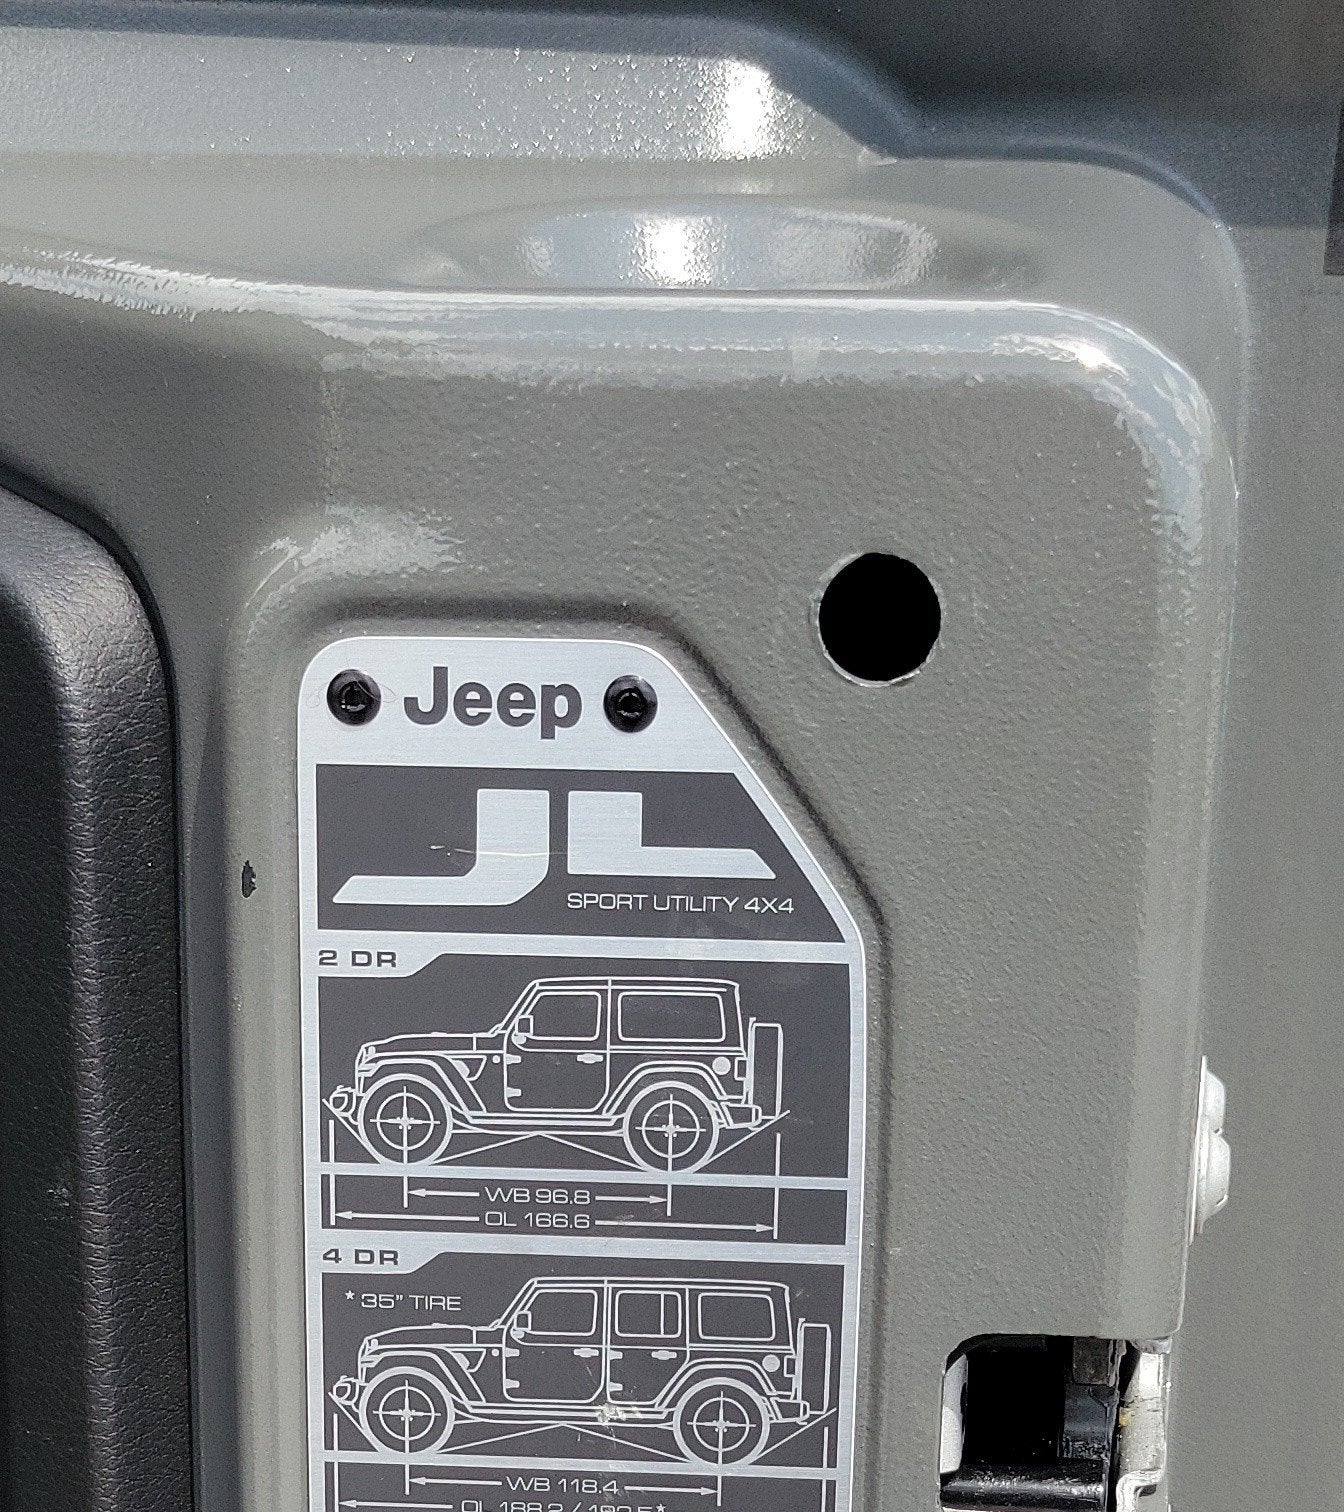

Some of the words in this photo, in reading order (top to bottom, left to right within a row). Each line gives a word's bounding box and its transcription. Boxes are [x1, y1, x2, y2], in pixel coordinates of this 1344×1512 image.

[403, 666, 582, 740] Jeep
[333, 788, 776, 906] JL
[567, 893, 648, 910] SPORT
[653, 895, 739, 912] UTILITY
[743, 897, 794, 914] 4X4
[318, 949, 338, 966] 2
[351, 950, 397, 967] DR
[484, 1186, 530, 1203] WB
[535, 1188, 590, 1205] 96.8
[484, 1211, 517, 1227] OL
[524, 1212, 590, 1229] 166.6
[322, 1248, 342, 1264] 4
[354, 1248, 398, 1265] DR
[408, 1294, 462, 1311] TIRE
[506, 1476, 550, 1492] WB
[557, 1478, 618, 1495] 118.4
